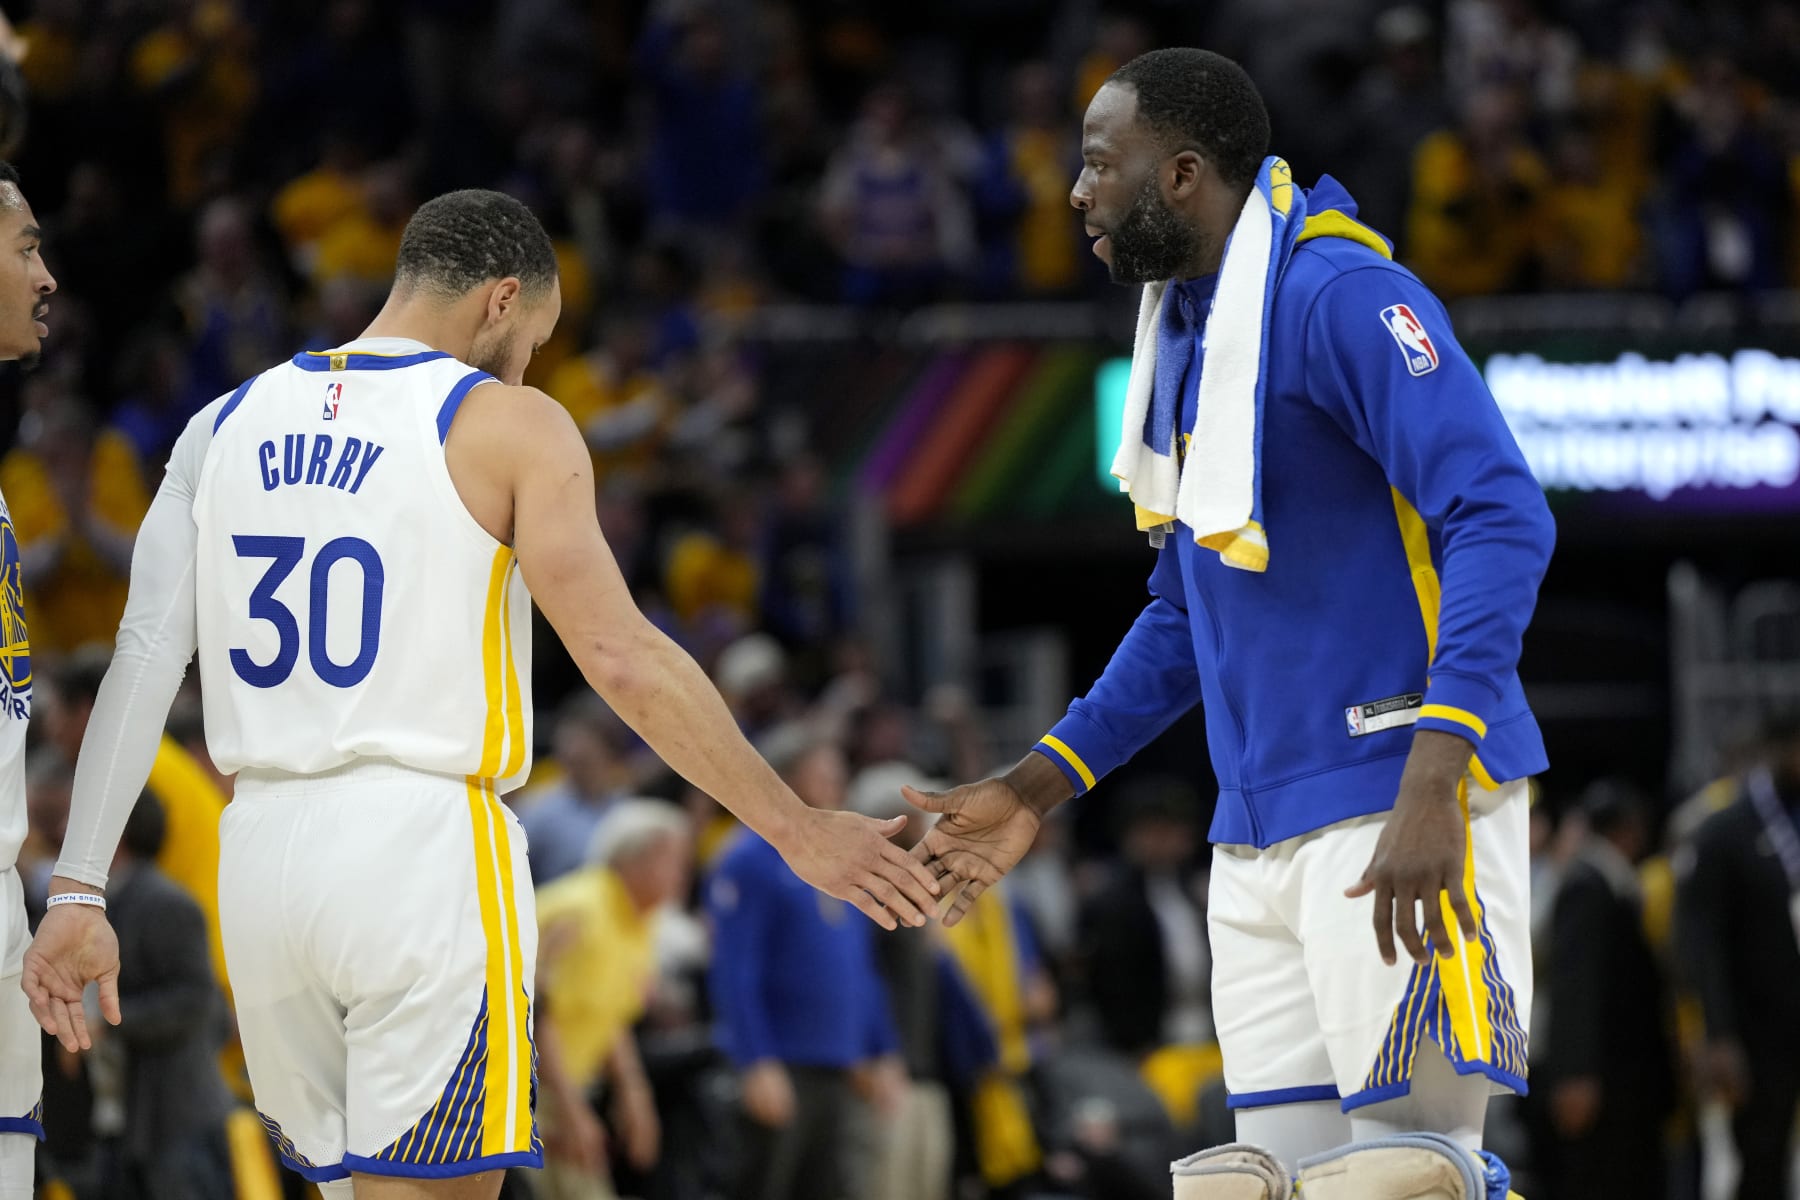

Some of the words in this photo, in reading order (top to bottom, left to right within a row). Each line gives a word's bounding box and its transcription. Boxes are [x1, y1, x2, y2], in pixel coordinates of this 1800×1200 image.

[1411, 354, 1431, 372] NBA
[258, 433, 385, 495] CURRY
[229, 534, 385, 689] 30
